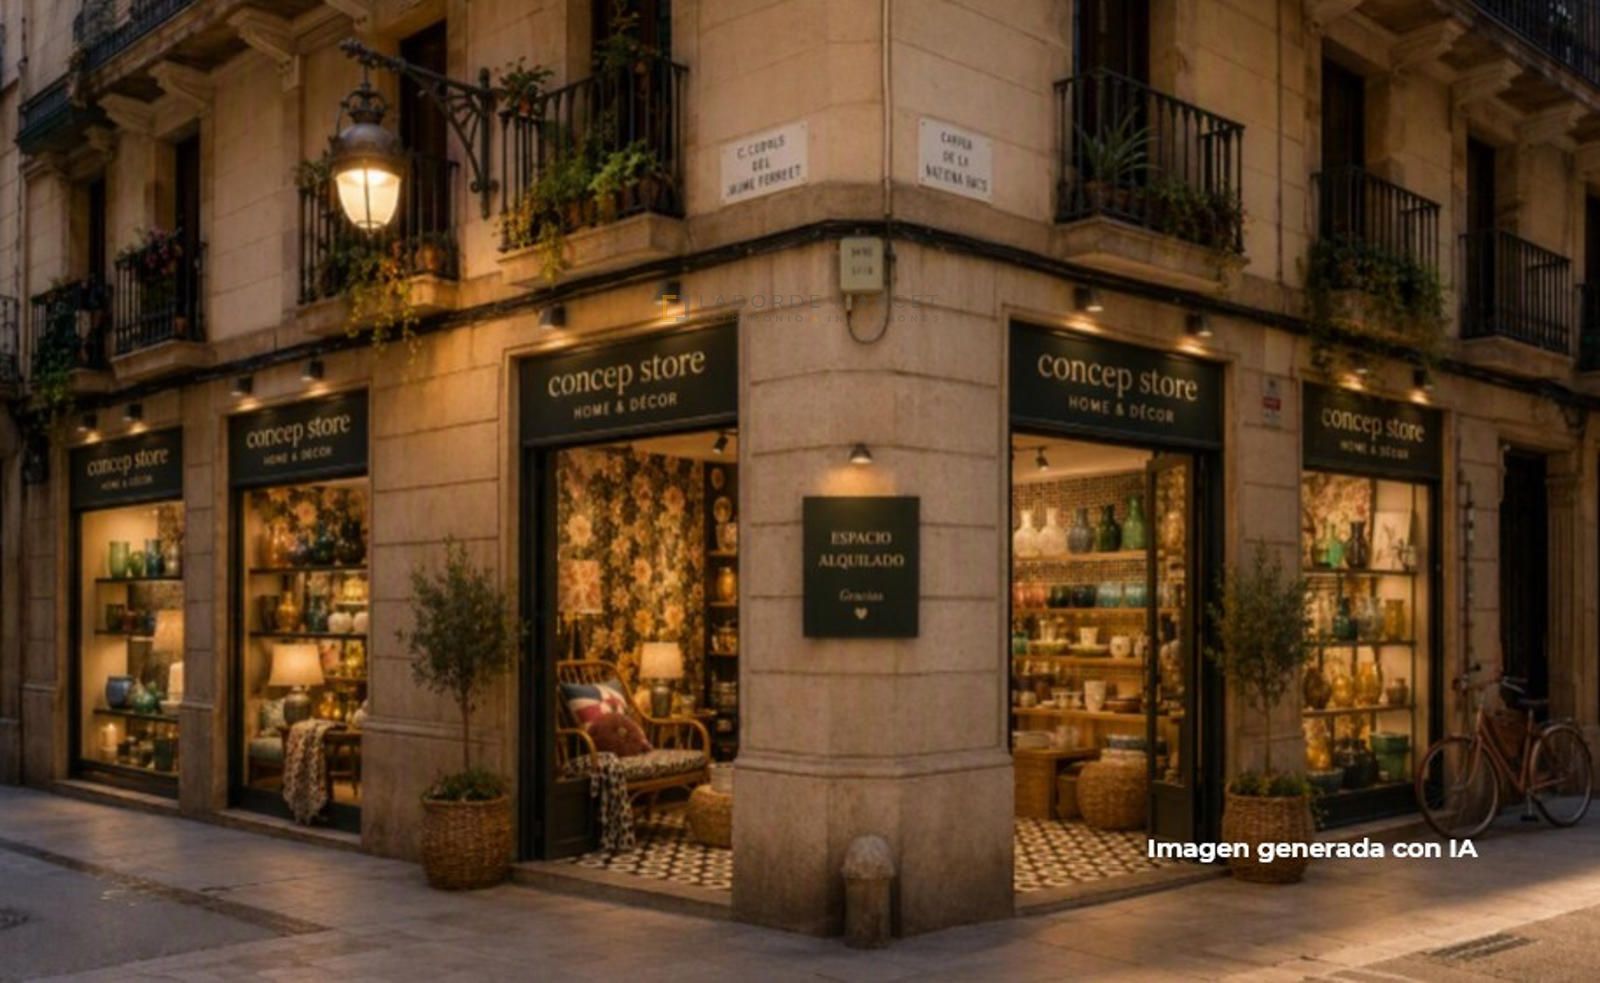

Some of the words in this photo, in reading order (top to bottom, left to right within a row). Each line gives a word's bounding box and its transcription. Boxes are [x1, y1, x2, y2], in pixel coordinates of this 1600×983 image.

[548, 363, 634, 398] concep
[640, 350, 706, 383] store
[1037, 353, 1133, 399] concep
[1139, 368, 1199, 401] store
[573, 401, 610, 419] HOME
[614, 400, 625, 414] &
[1068, 395, 1111, 415] HOME
[1113, 402, 1125, 416] &
[246, 423, 304, 449] concep
[307, 413, 351, 438] store
[1321, 408, 1383, 441] concep
[1386, 418, 1425, 443] store
[87, 454, 135, 477] concep
[134, 448, 169, 468] store
[831, 531, 892, 545] ESPACIO
[818, 553, 905, 570] ALQUILADO
